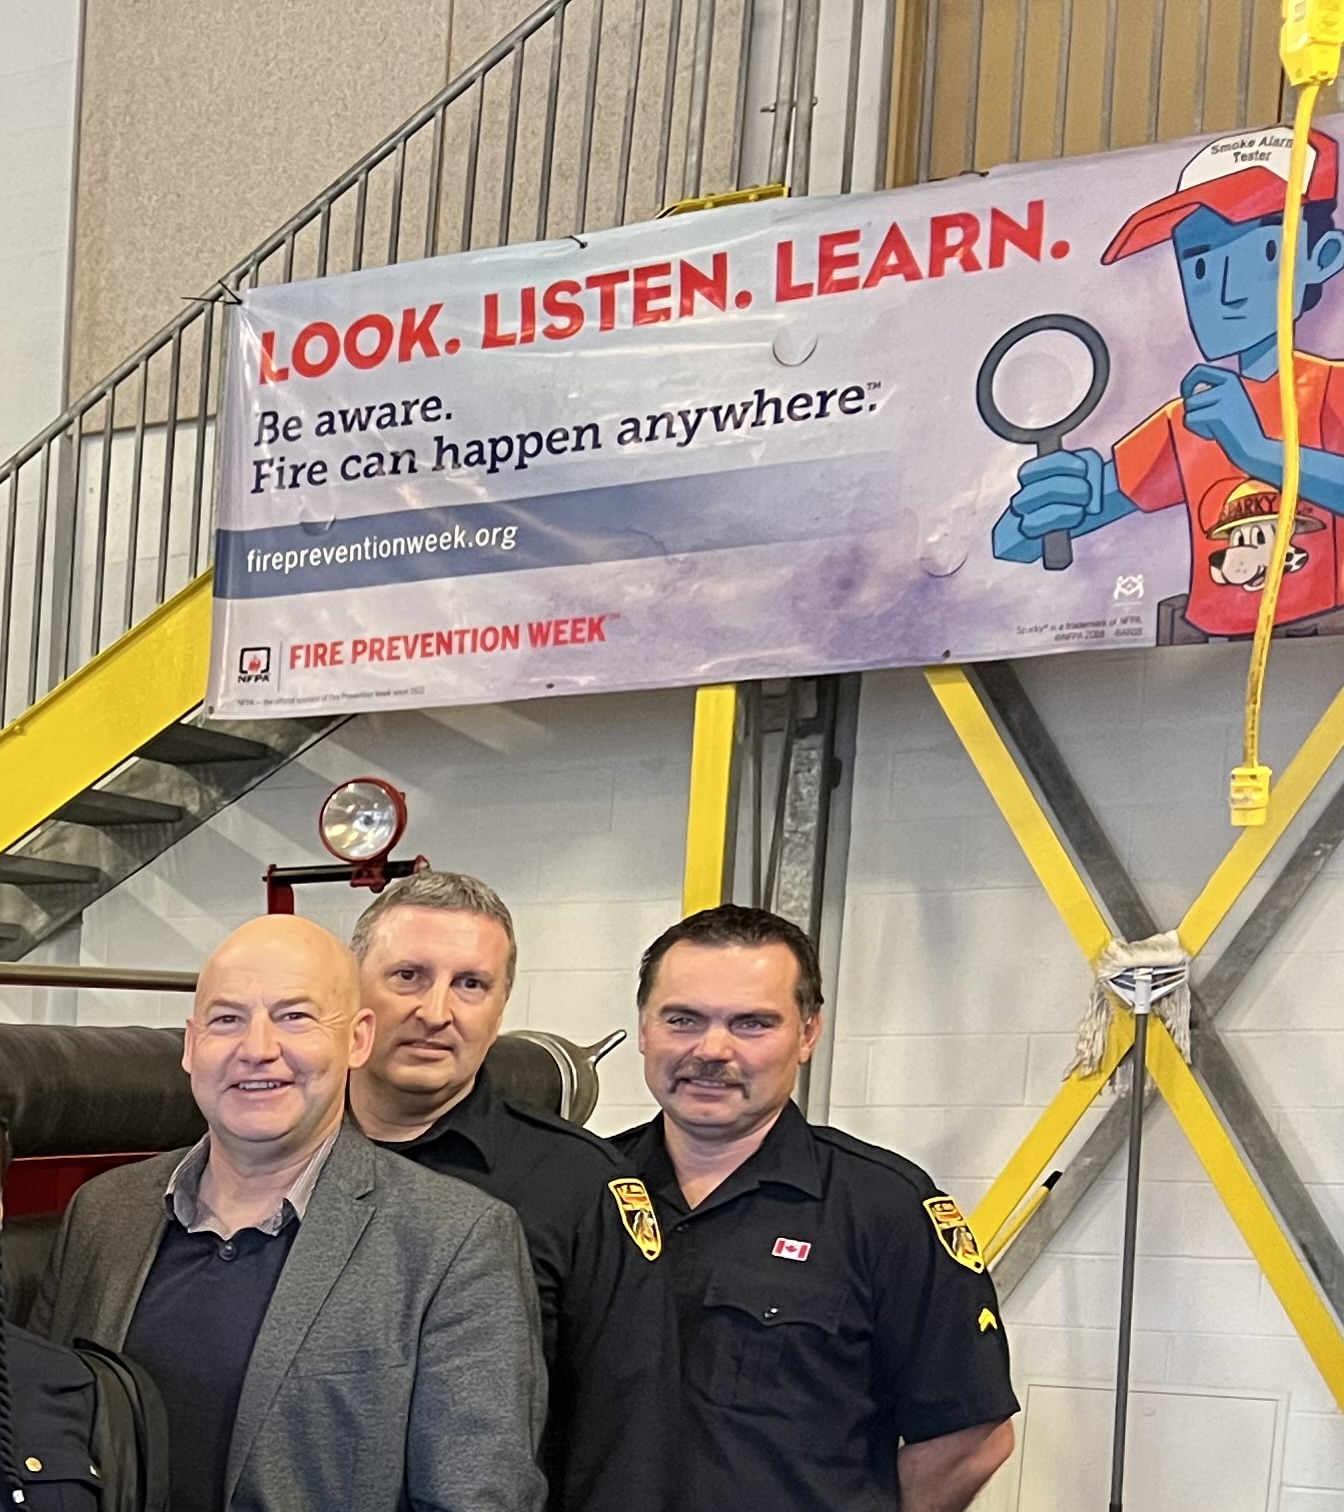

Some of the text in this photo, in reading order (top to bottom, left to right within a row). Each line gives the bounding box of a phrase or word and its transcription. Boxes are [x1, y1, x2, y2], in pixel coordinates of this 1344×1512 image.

[1210, 138, 1256, 155] Smoke
[1233, 150, 1272, 163] Tester
[259, 199, 1071, 385] LOOK. LISTEN. LEARN.
[253, 395, 453, 447] Be aware.
[250, 455, 328, 493] Fire
[340, 448, 418, 482] can
[431, 418, 602, 475] happen
[246, 524, 518, 575] firepreventionweek.org
[288, 640, 345, 670] FIRE
[350, 623, 521, 665] PREVENTION
[237, 674, 271, 684] NFPA
